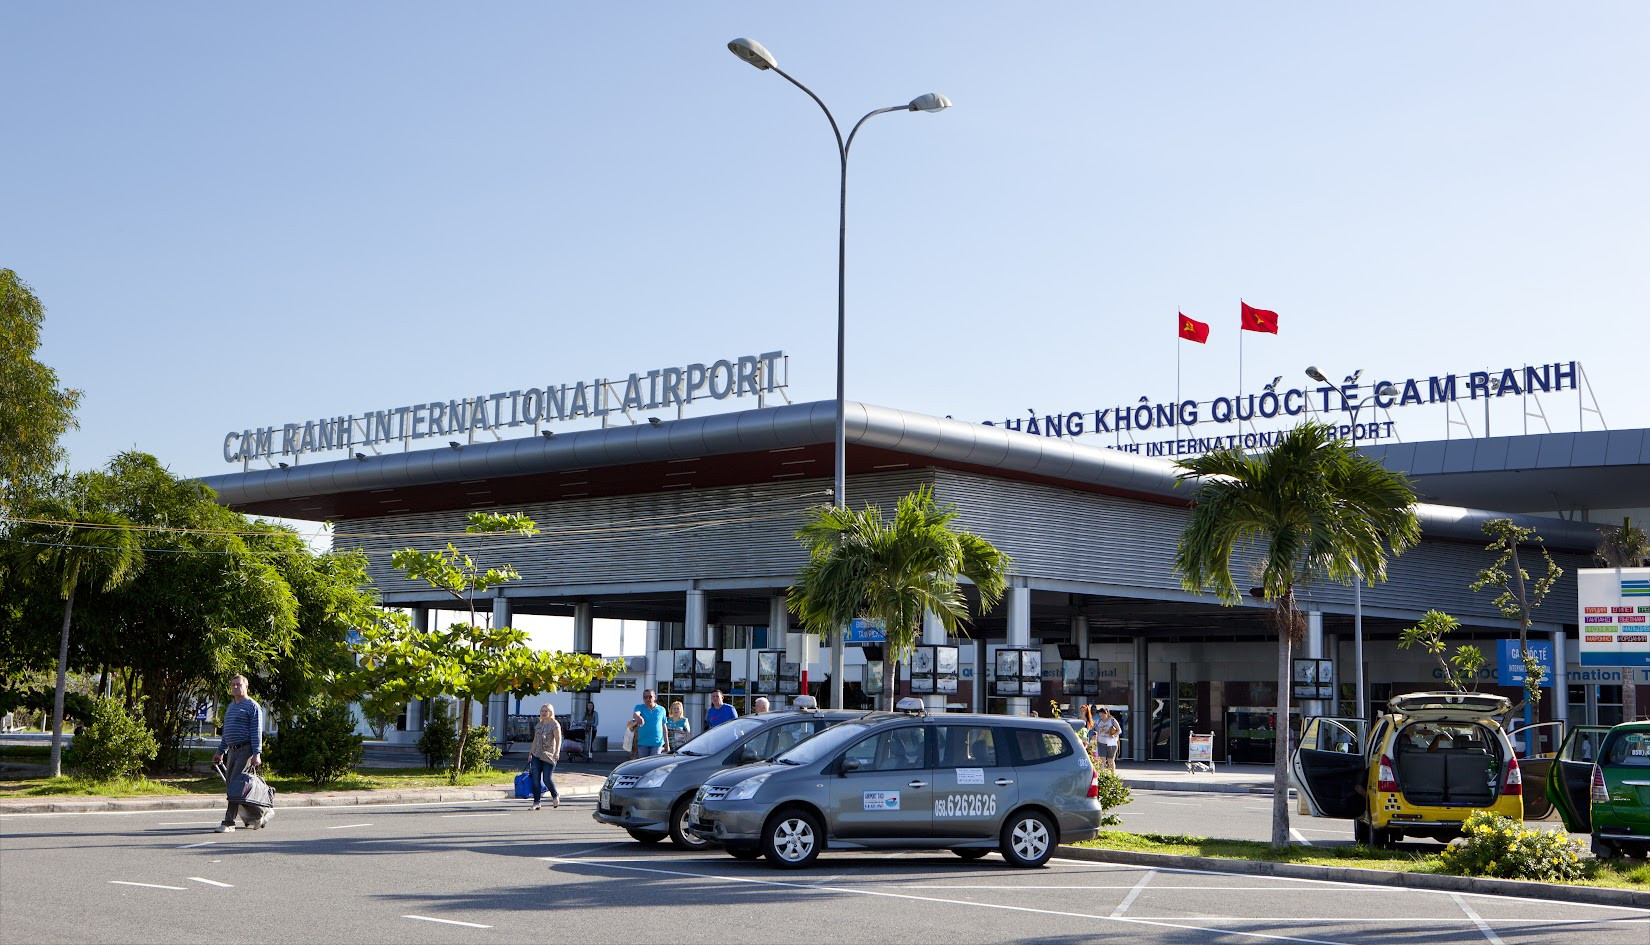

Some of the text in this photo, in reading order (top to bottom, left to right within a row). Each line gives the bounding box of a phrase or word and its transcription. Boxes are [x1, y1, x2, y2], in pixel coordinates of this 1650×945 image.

[223, 350, 785, 463] CAM RANH INTERNATIONAL AIRPORT
[1095, 395, 1198, 433] KHÔNG
[1211, 375, 1304, 423] QUỐC
[1316, 369, 1364, 413] TẾ
[1374, 373, 1457, 409] CAM
[1469, 360, 1578, 400] RANH
[1146, 429, 1295, 456] INTERNATIONA
